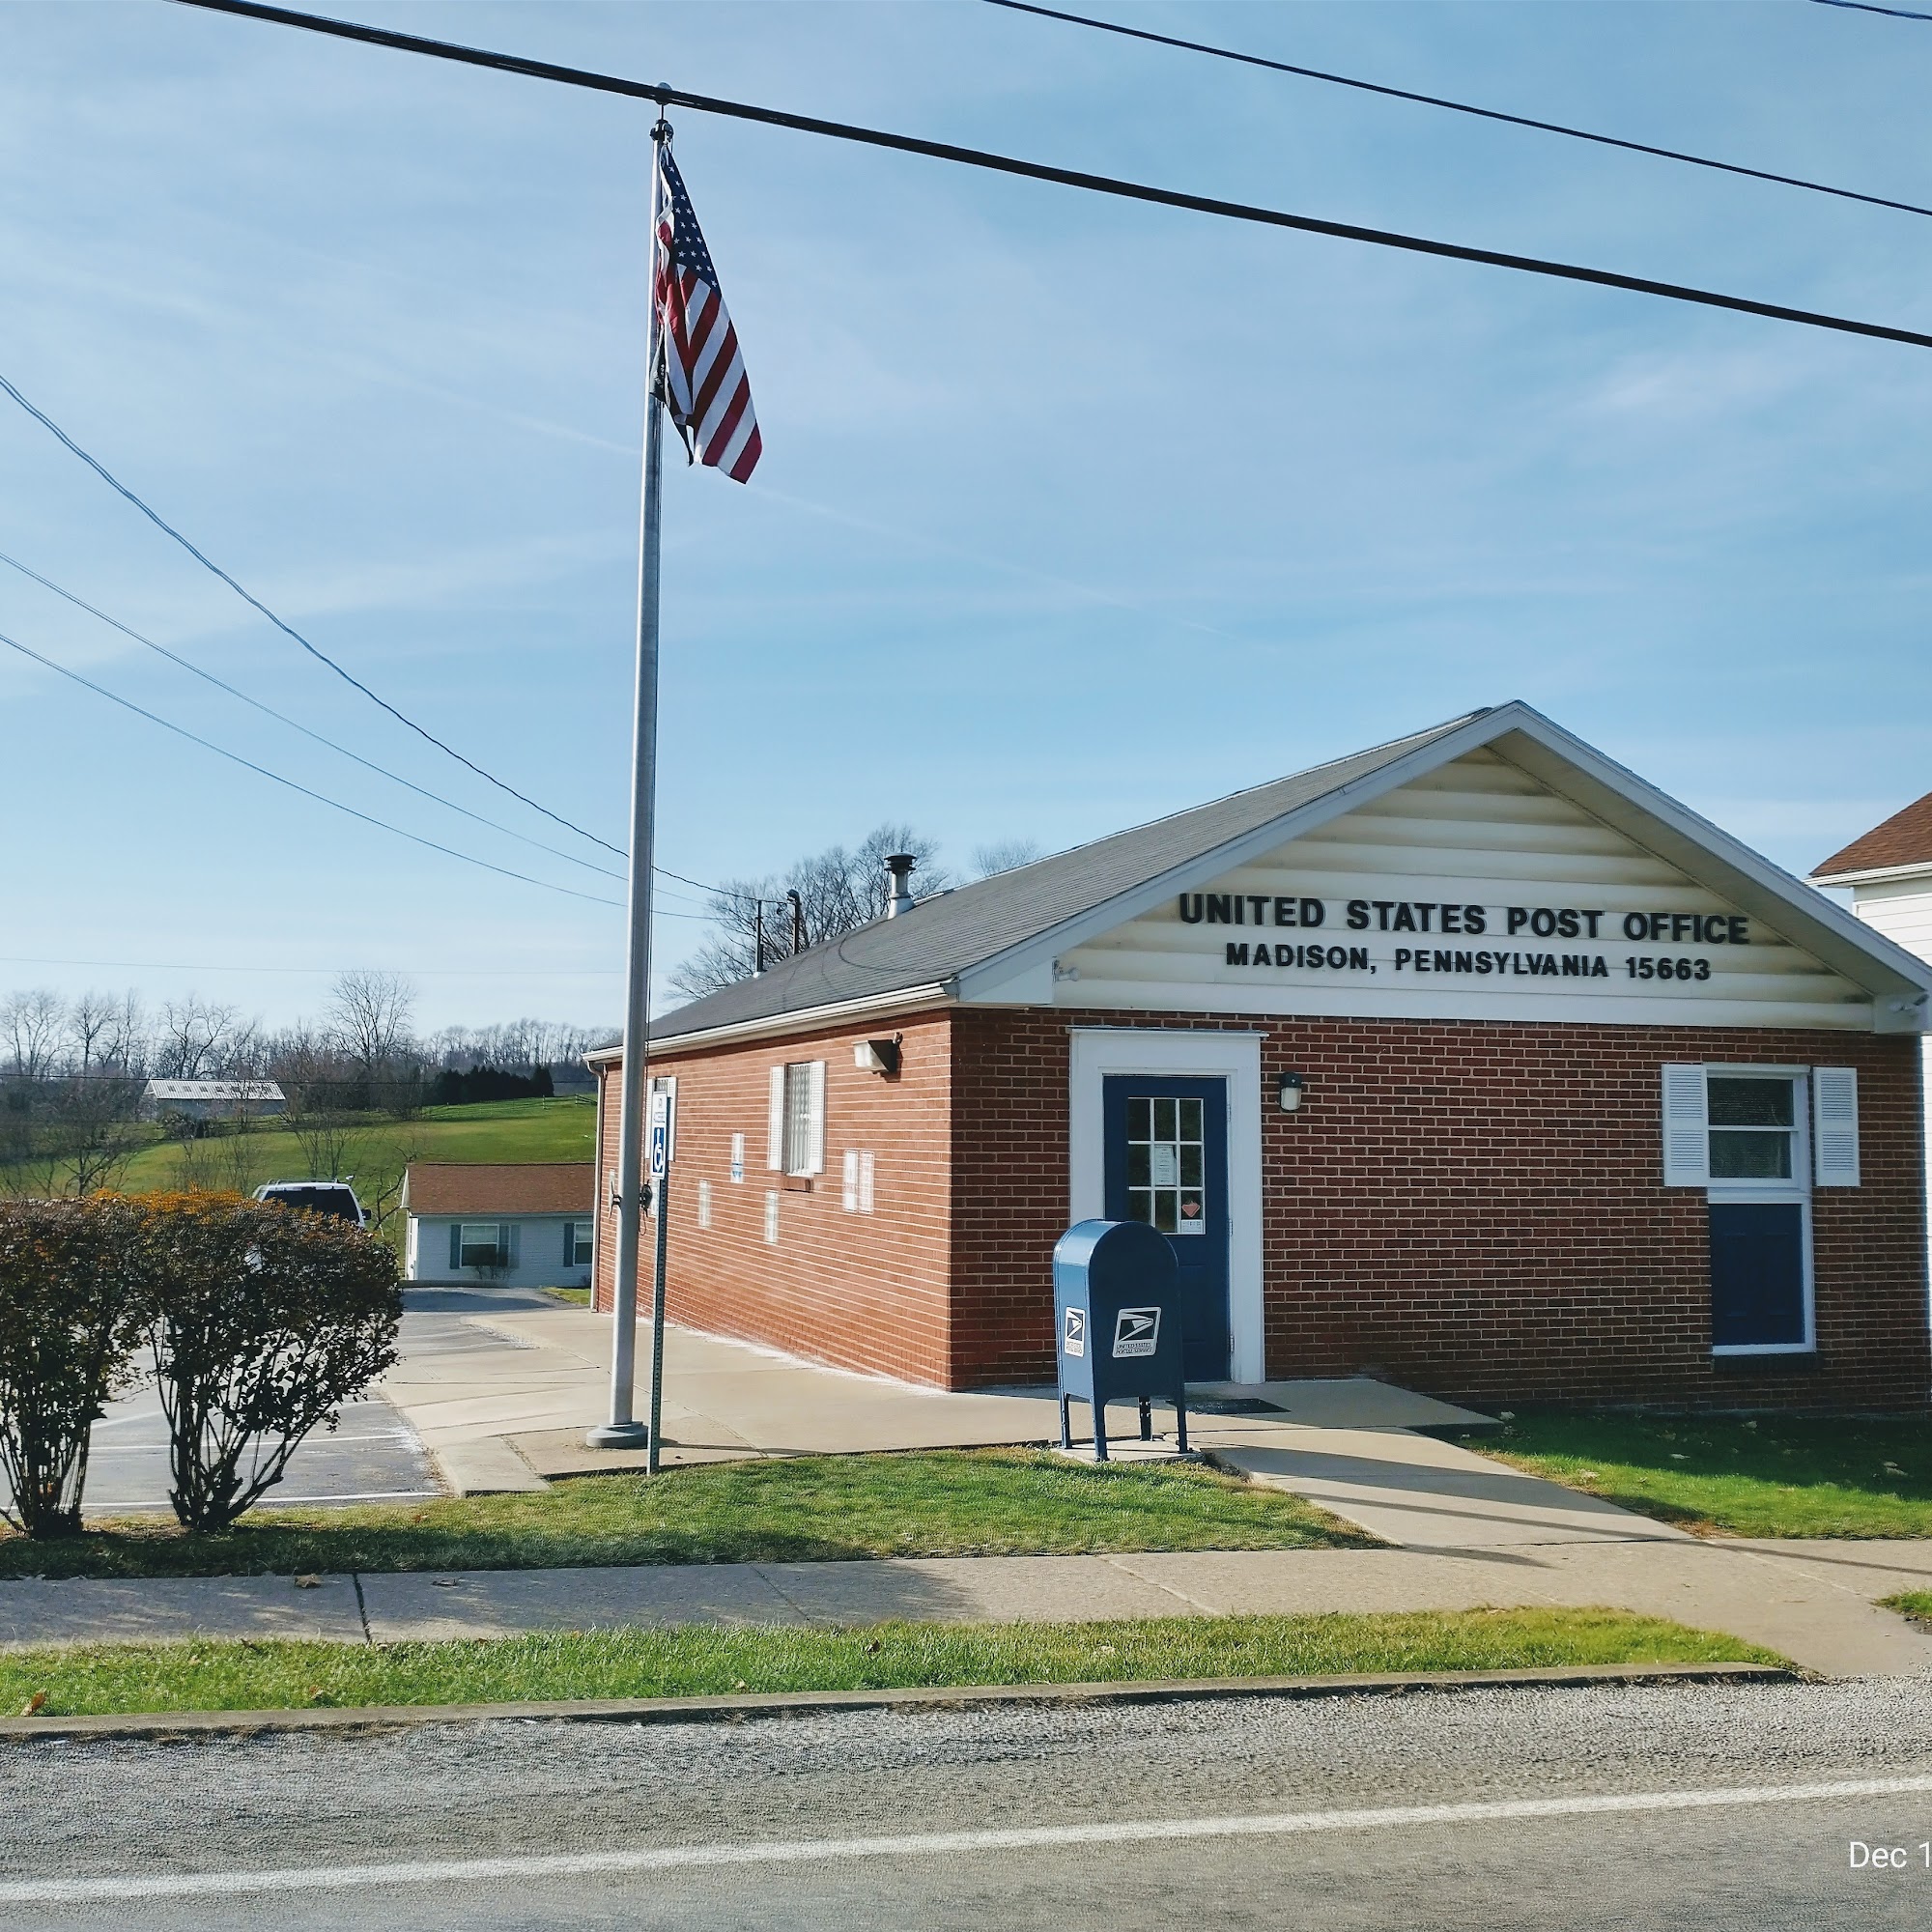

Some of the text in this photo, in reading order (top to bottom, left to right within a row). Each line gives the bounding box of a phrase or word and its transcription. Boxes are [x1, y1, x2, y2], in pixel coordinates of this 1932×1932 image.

[1179, 893, 1750, 945] UNITED STATES POST OFFICE
[1226, 942, 1712, 980] MADISON, PENNSYLVANIA 15663
